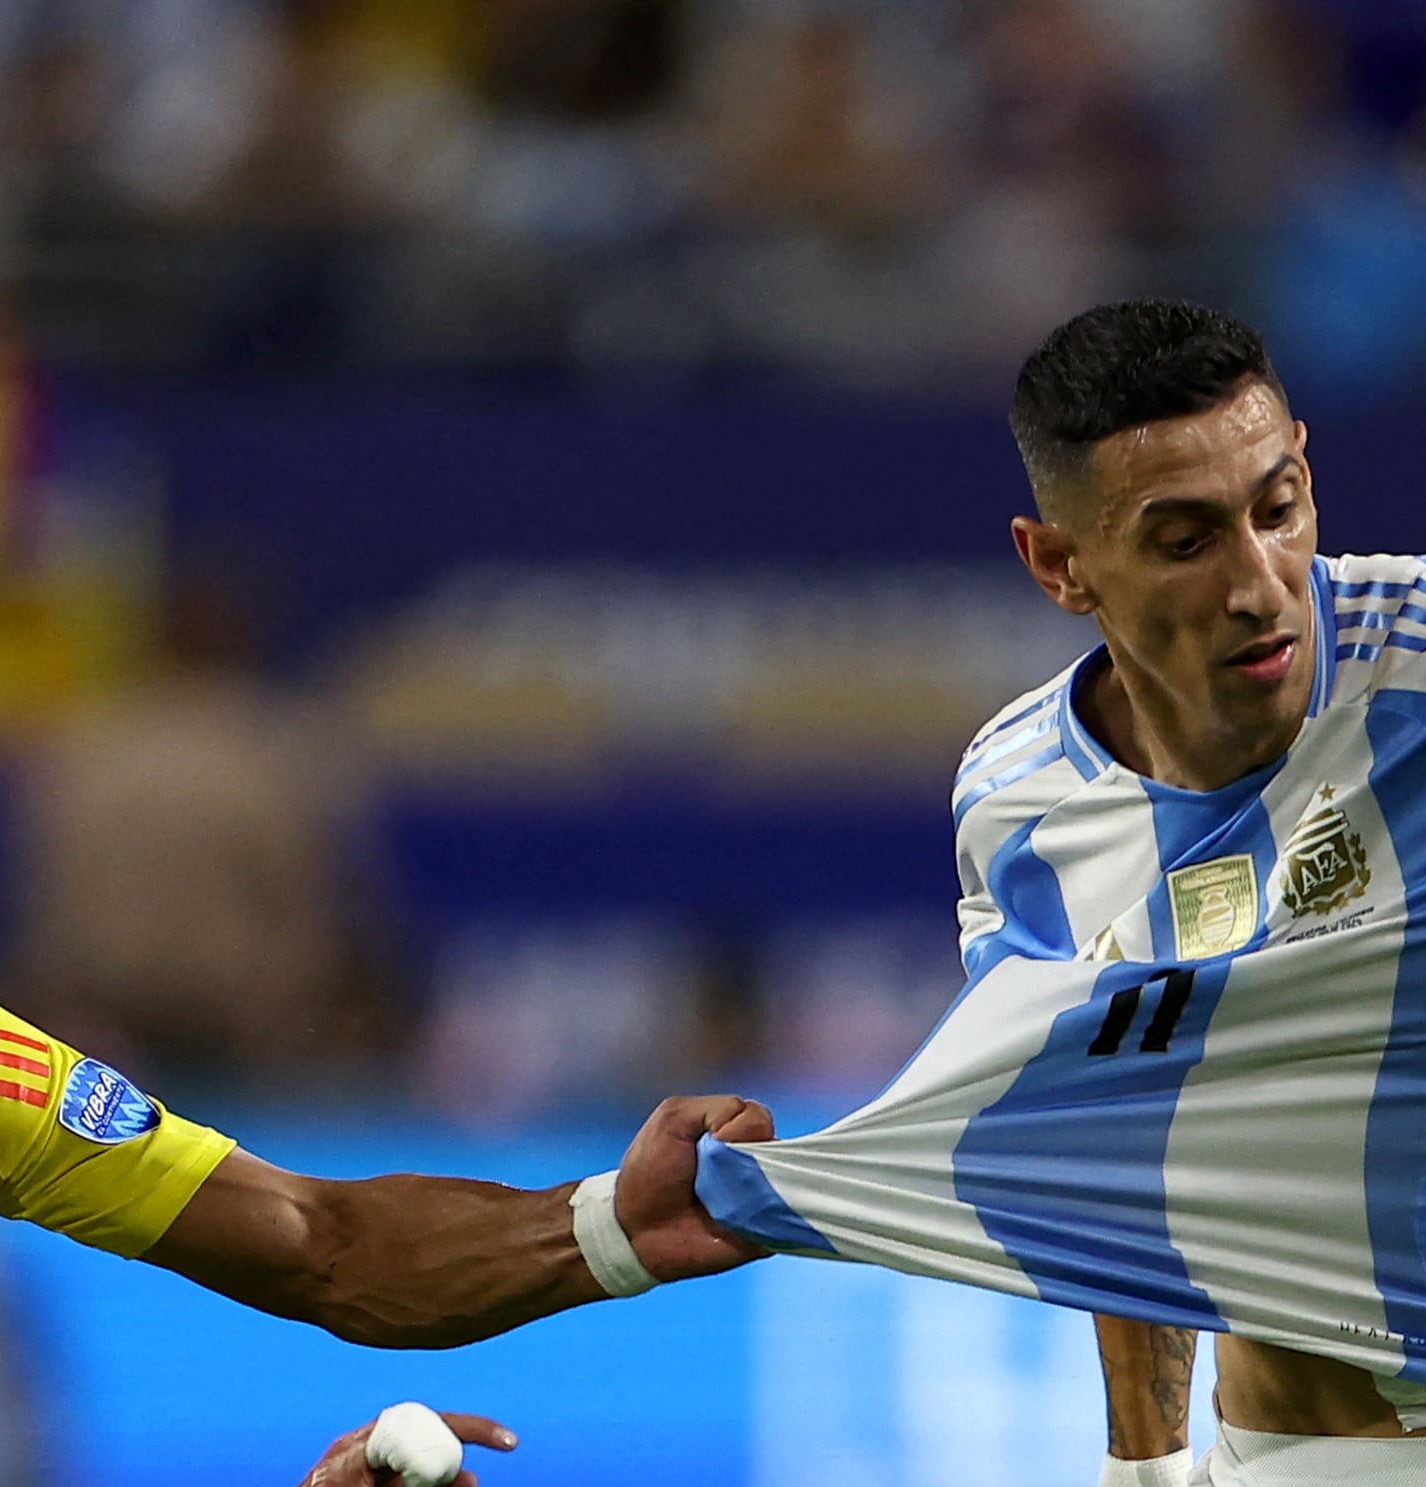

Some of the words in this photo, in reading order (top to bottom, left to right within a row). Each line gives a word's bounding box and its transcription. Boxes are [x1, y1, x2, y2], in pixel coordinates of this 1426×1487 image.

[1297, 843, 1348, 896] AFA
[1087, 968, 1195, 1056] 11
[81, 1072, 116, 1130] VIBRA
